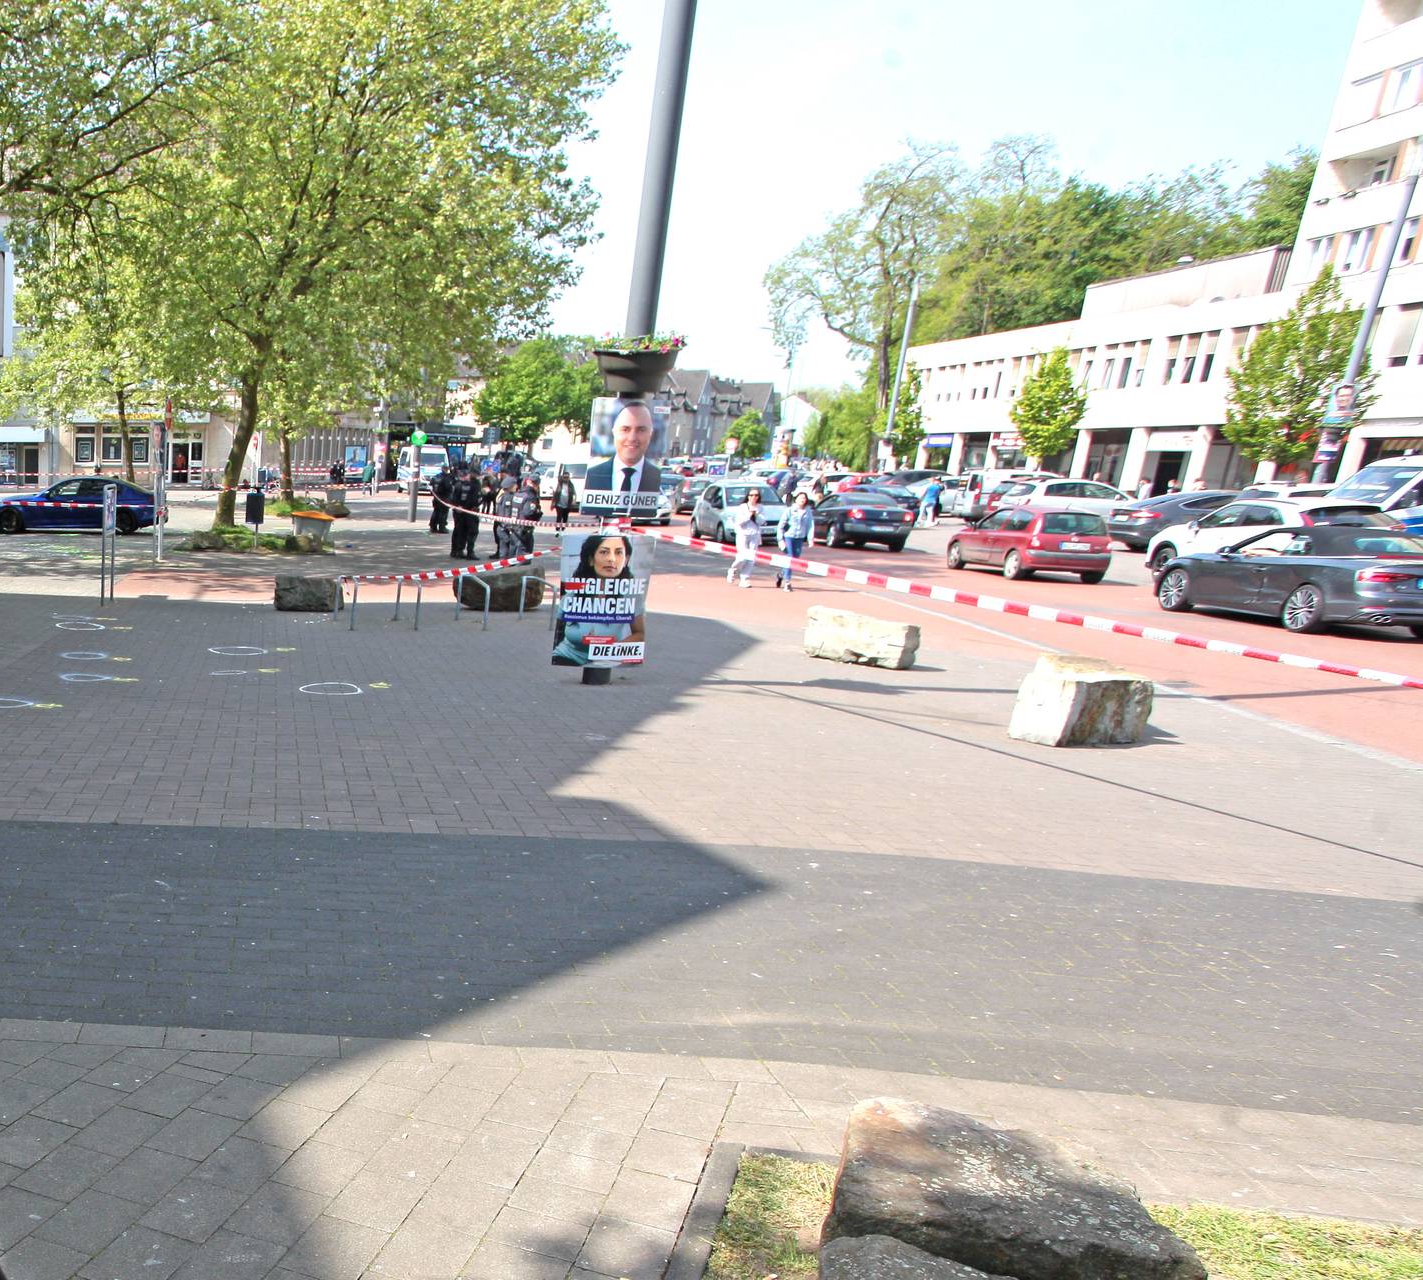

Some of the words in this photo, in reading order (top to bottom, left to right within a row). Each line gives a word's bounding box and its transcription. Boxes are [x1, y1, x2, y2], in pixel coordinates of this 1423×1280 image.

[586, 493, 620, 505] DENIZ
[562, 596, 636, 614] CHANCEN
[593, 646, 609, 657] DIE
